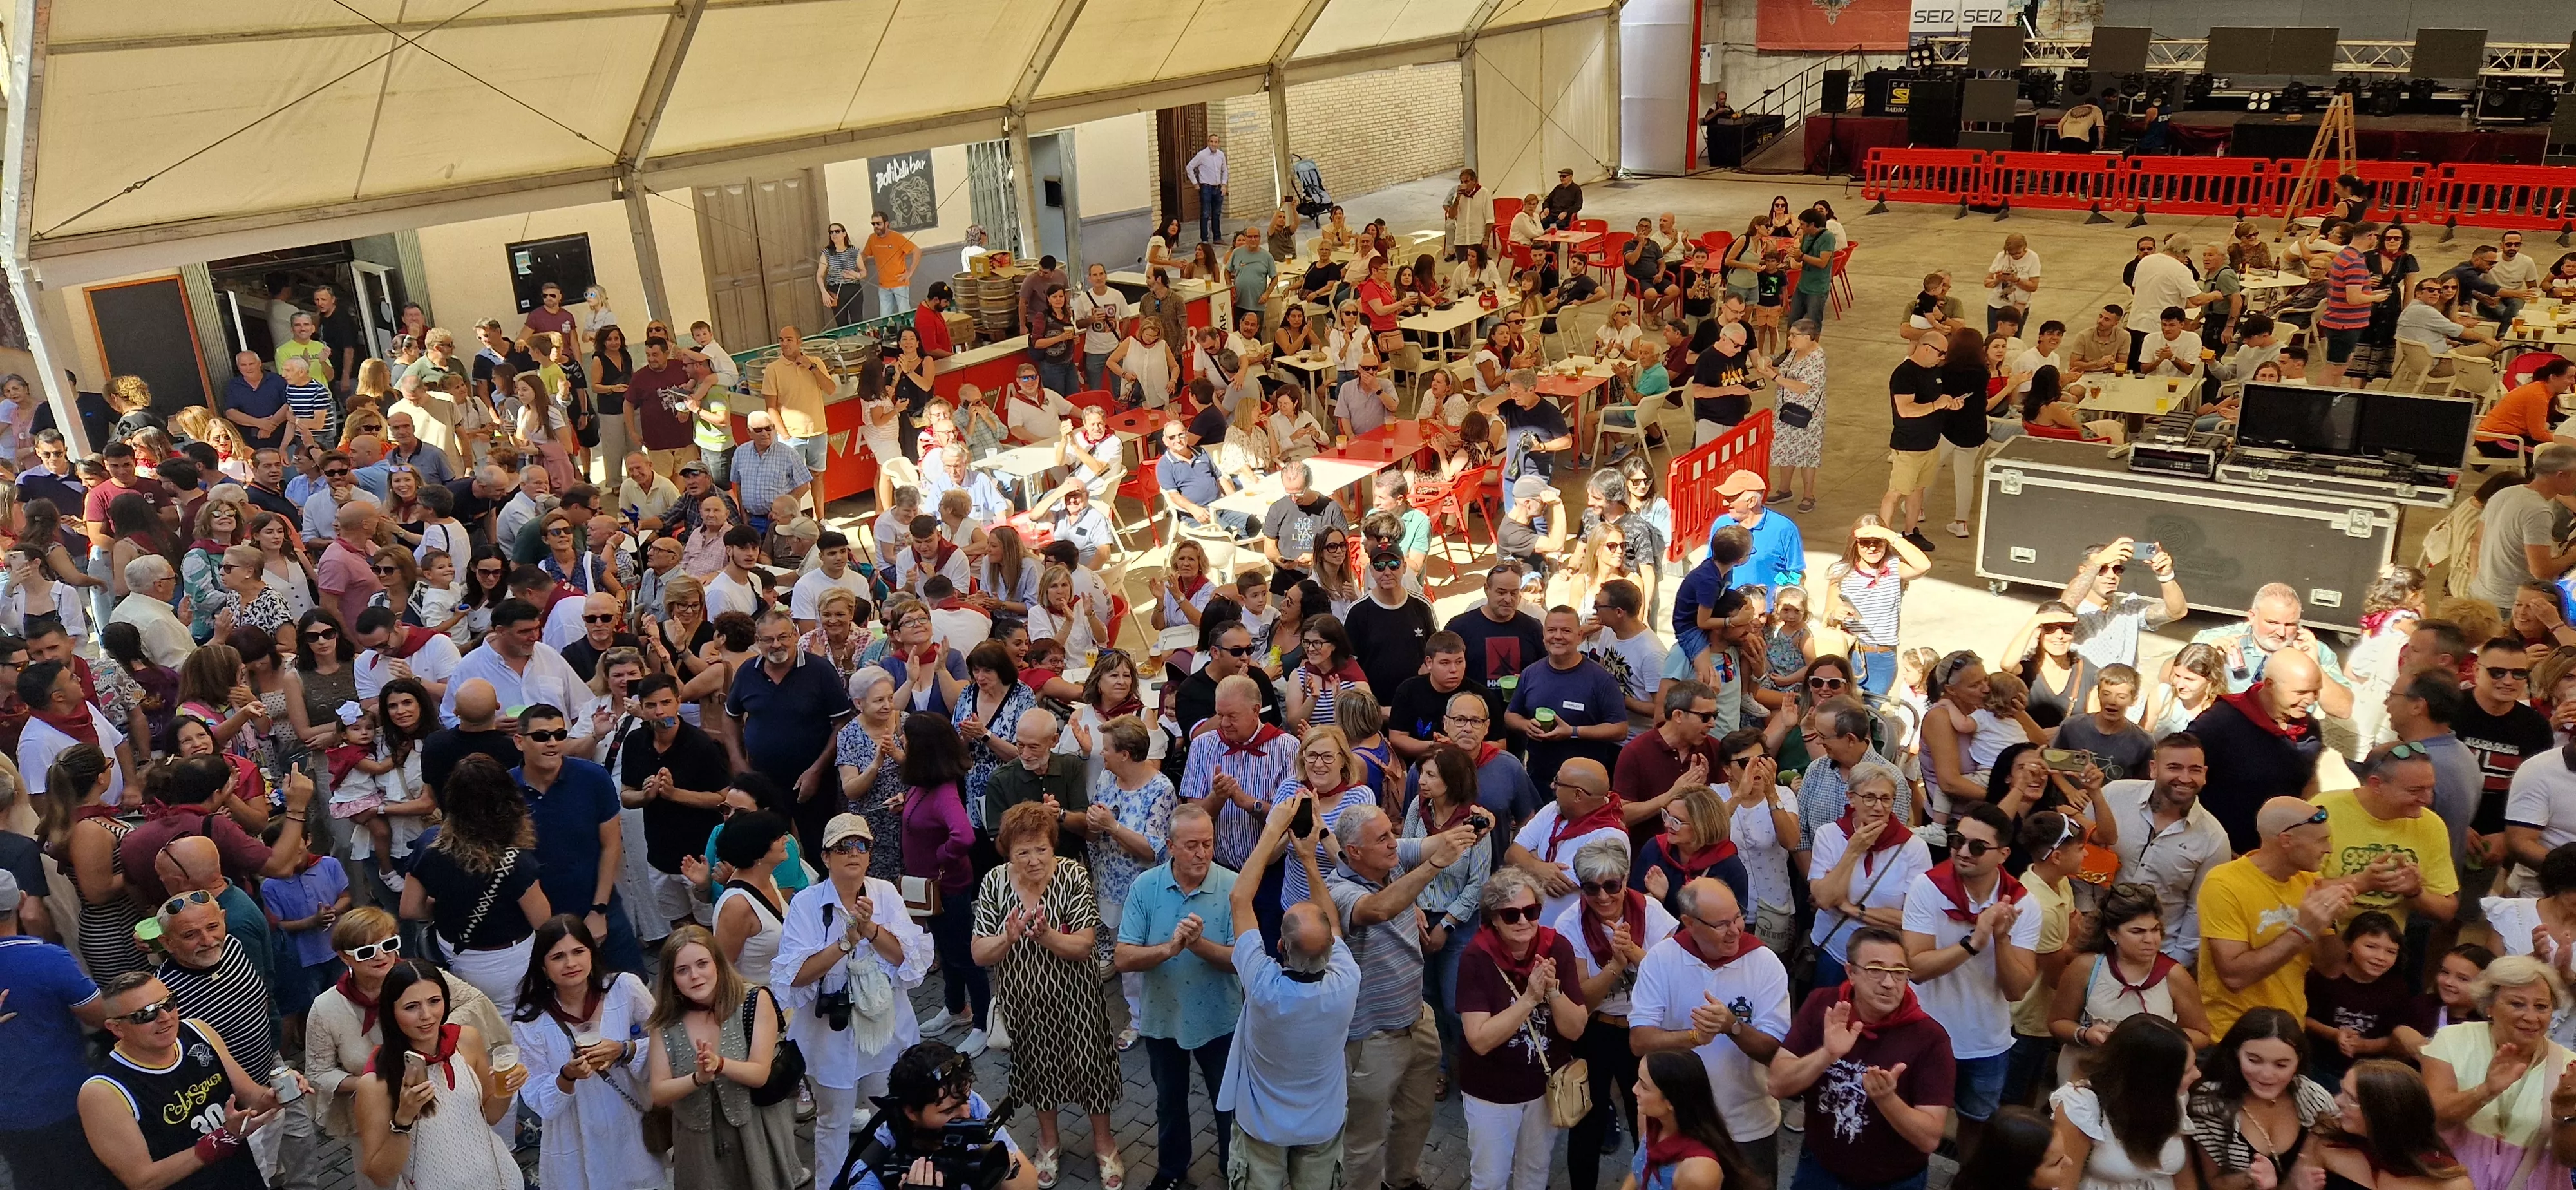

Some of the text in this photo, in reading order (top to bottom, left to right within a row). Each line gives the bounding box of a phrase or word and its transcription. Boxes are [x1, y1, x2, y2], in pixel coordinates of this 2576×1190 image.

[1913, 10, 1954, 23] SER
[1963, 9, 2002, 23] SER
[909, 156, 926, 174] bar
[984, 389, 998, 398] 1900
[830, 433, 846, 442] 1900
[191, 1102, 227, 1138] 30
